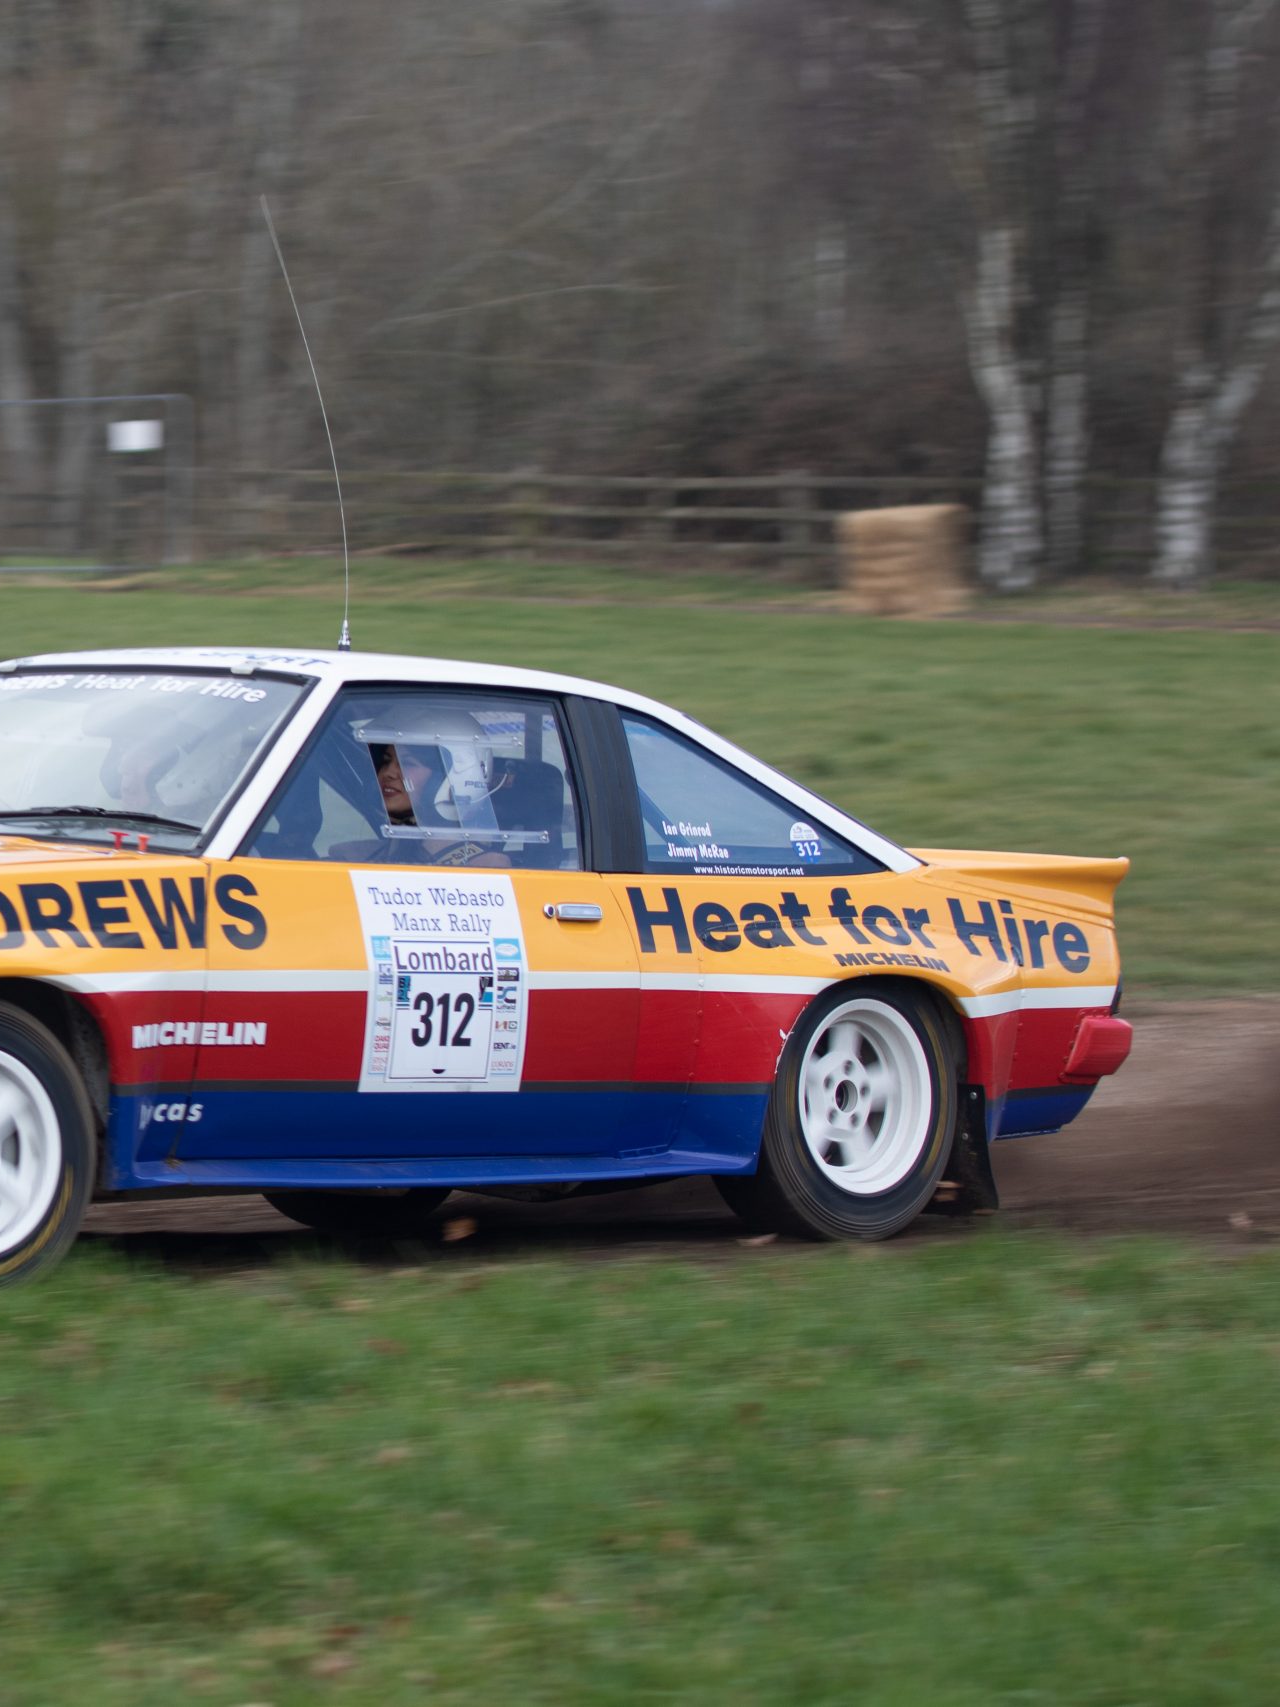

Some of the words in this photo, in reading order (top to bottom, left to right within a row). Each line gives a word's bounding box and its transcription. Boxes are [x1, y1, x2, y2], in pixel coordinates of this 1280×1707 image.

[74, 673, 147, 691] Heat
[150, 674, 198, 693] for
[200, 678, 268, 703] Hire
[662, 820, 678, 836] Ian
[667, 843, 698, 861] Jimmy
[699, 844, 729, 860] McRae
[795, 842, 821, 857] 312
[693, 865, 805, 877] www.historicmotorsport.net
[368, 887, 423, 906] Tudor
[428, 888, 505, 907] Webasto
[391, 912, 442, 932] Manx
[447, 913, 491, 936] Rally
[625, 886, 828, 954] Heat
[829, 887, 935, 949] for
[945, 896, 1091, 974] Hire
[393, 945, 494, 972] Lombard
[833, 952, 951, 974] MICHELIN
[411, 991, 475, 1048] 312
[131, 1021, 268, 1050] MICHELIN
